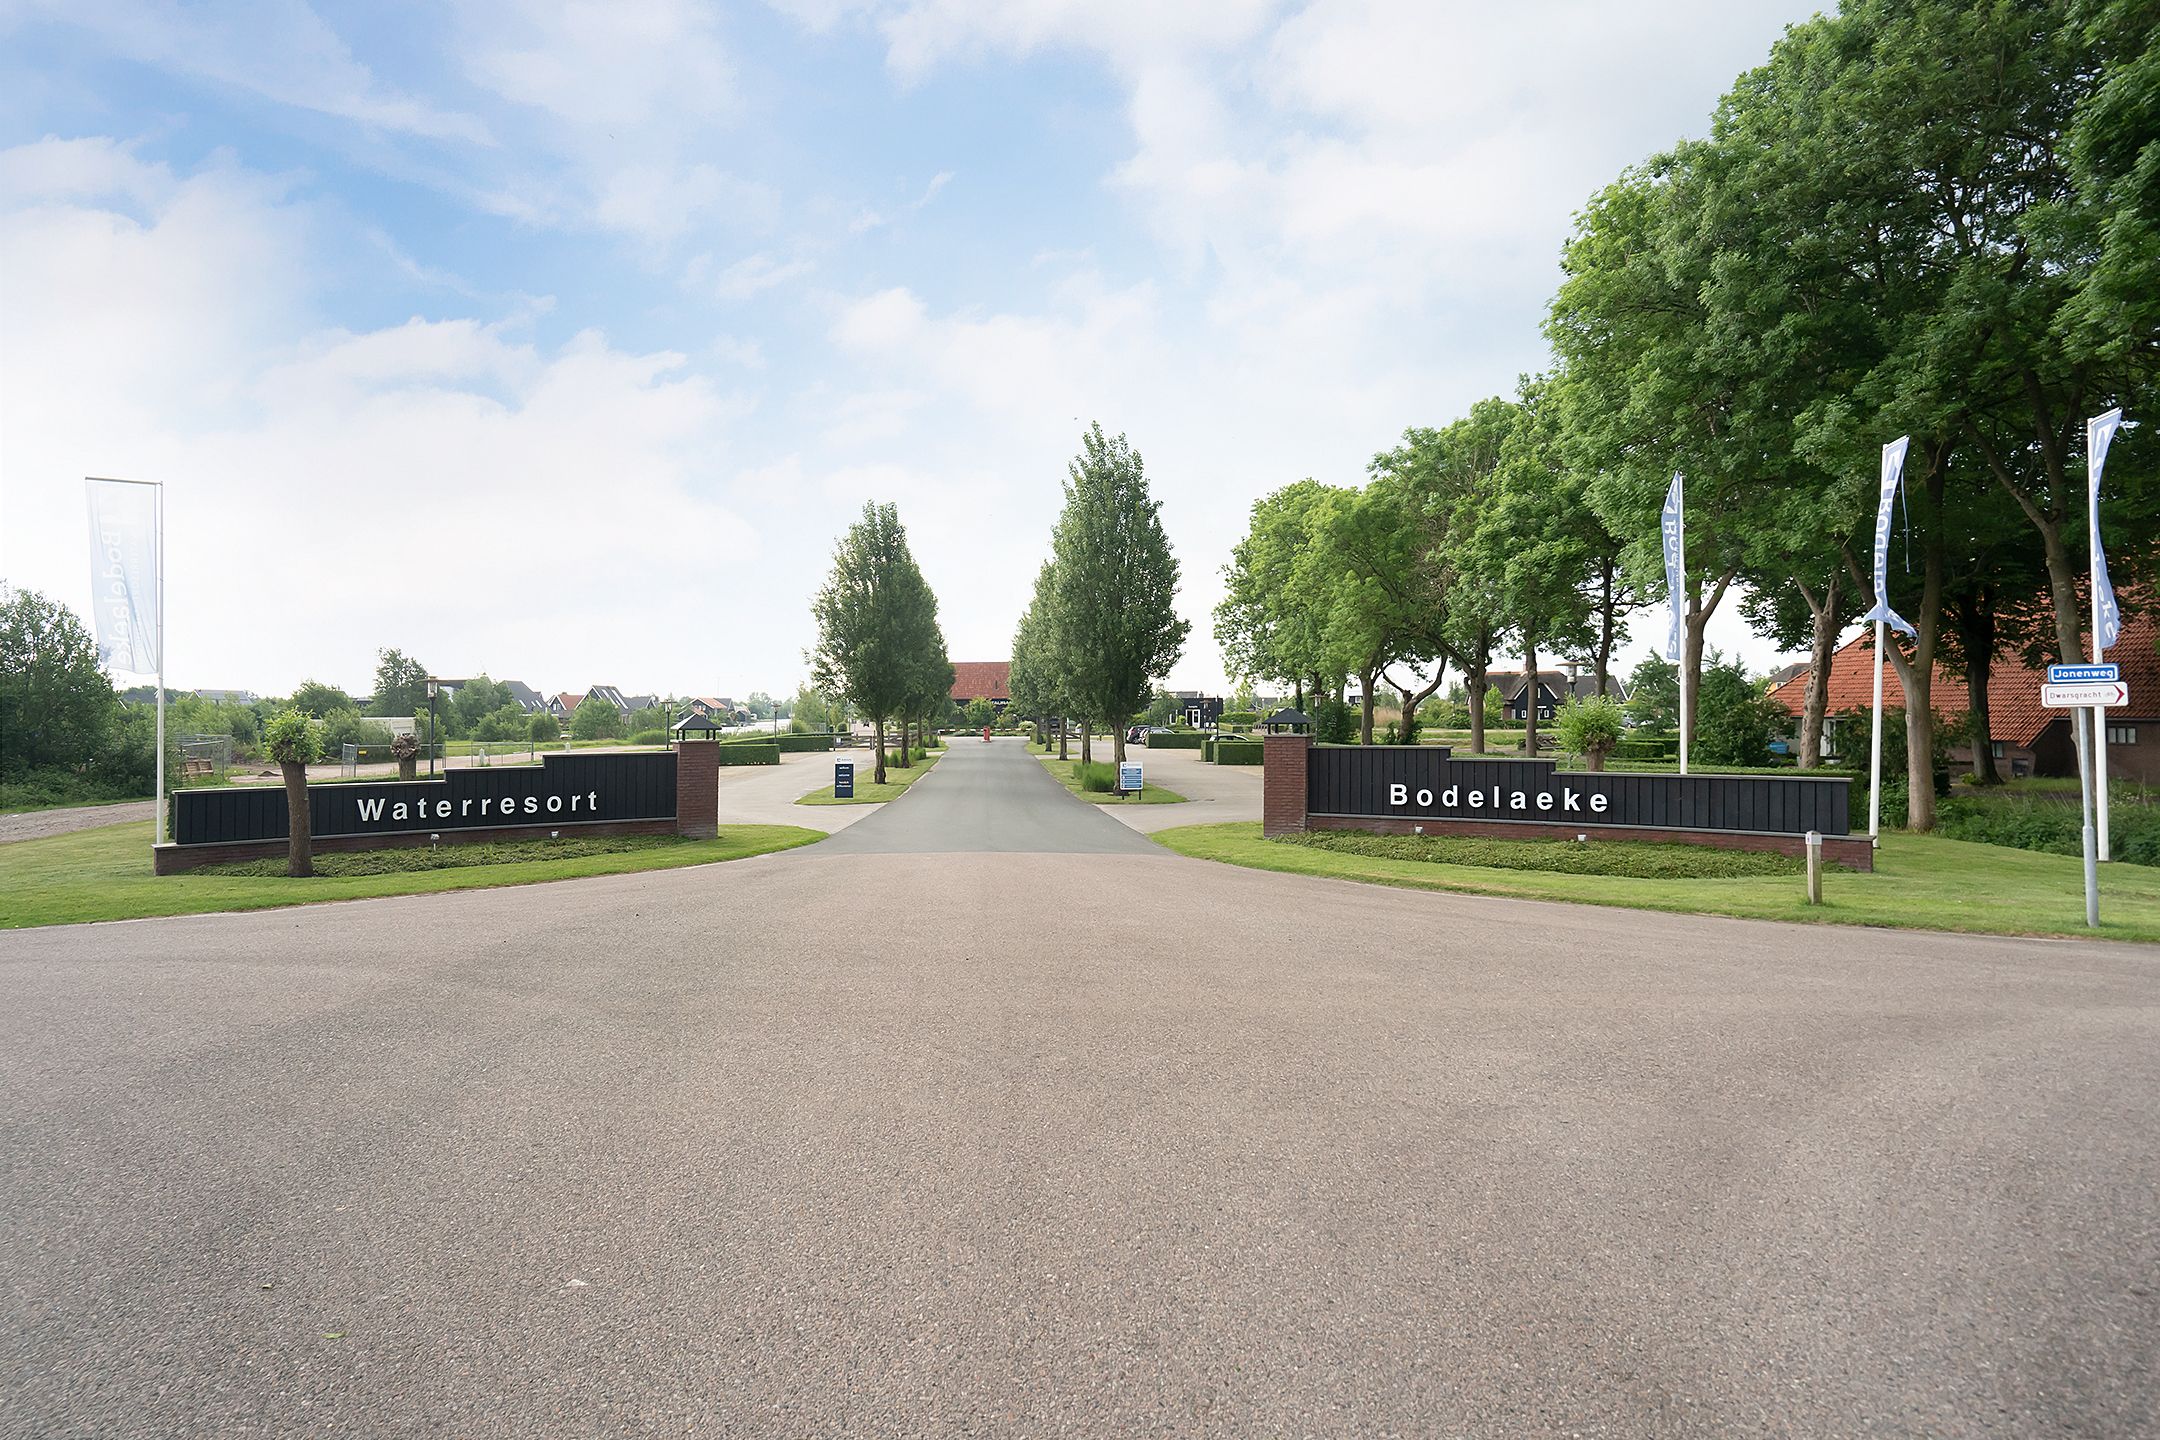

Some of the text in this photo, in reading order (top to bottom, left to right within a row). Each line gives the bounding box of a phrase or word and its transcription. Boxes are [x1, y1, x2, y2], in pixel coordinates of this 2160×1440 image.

[2054, 669, 2114, 679] Jonenweg
[2049, 691, 2102, 700] Dwarsgracht
[356, 790, 598, 822] Waterresort
[1389, 783, 1608, 812] Bodelaeke
